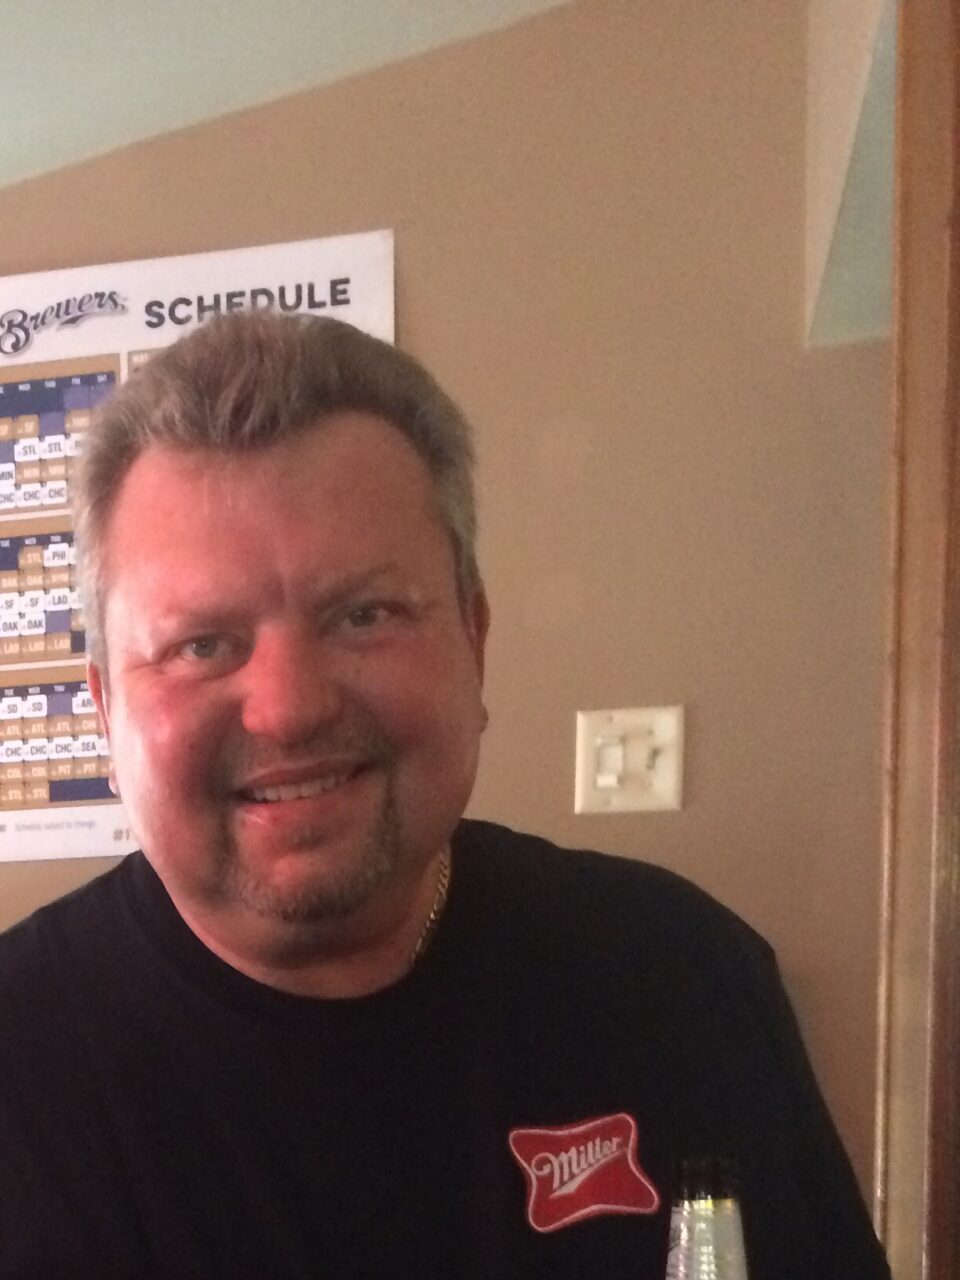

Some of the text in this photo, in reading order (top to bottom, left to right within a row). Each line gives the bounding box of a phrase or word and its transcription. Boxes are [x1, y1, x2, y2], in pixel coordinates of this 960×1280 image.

[144, 277, 351, 329] SCHEDULE
[22, 445, 37, 456] STL
[48, 442, 63, 453] STL
[23, 490, 40, 501] CHC
[48, 487, 65, 498] CHC
[52, 550, 66, 561] PHI
[5, 600, 14, 610] SF
[30, 598, 39, 608] SF
[52, 595, 68, 606] LAD
[2, 621, 18, 632] OAK
[27, 619, 43, 629] OAK
[7, 703, 18, 713] SD
[32, 702, 43, 712] SD
[5, 747, 22, 757] CHC
[30, 745, 47, 755] CHC
[55, 742, 72, 753] CHC
[81, 741, 96, 752] SEA
[532, 1135, 623, 1196] Miller
